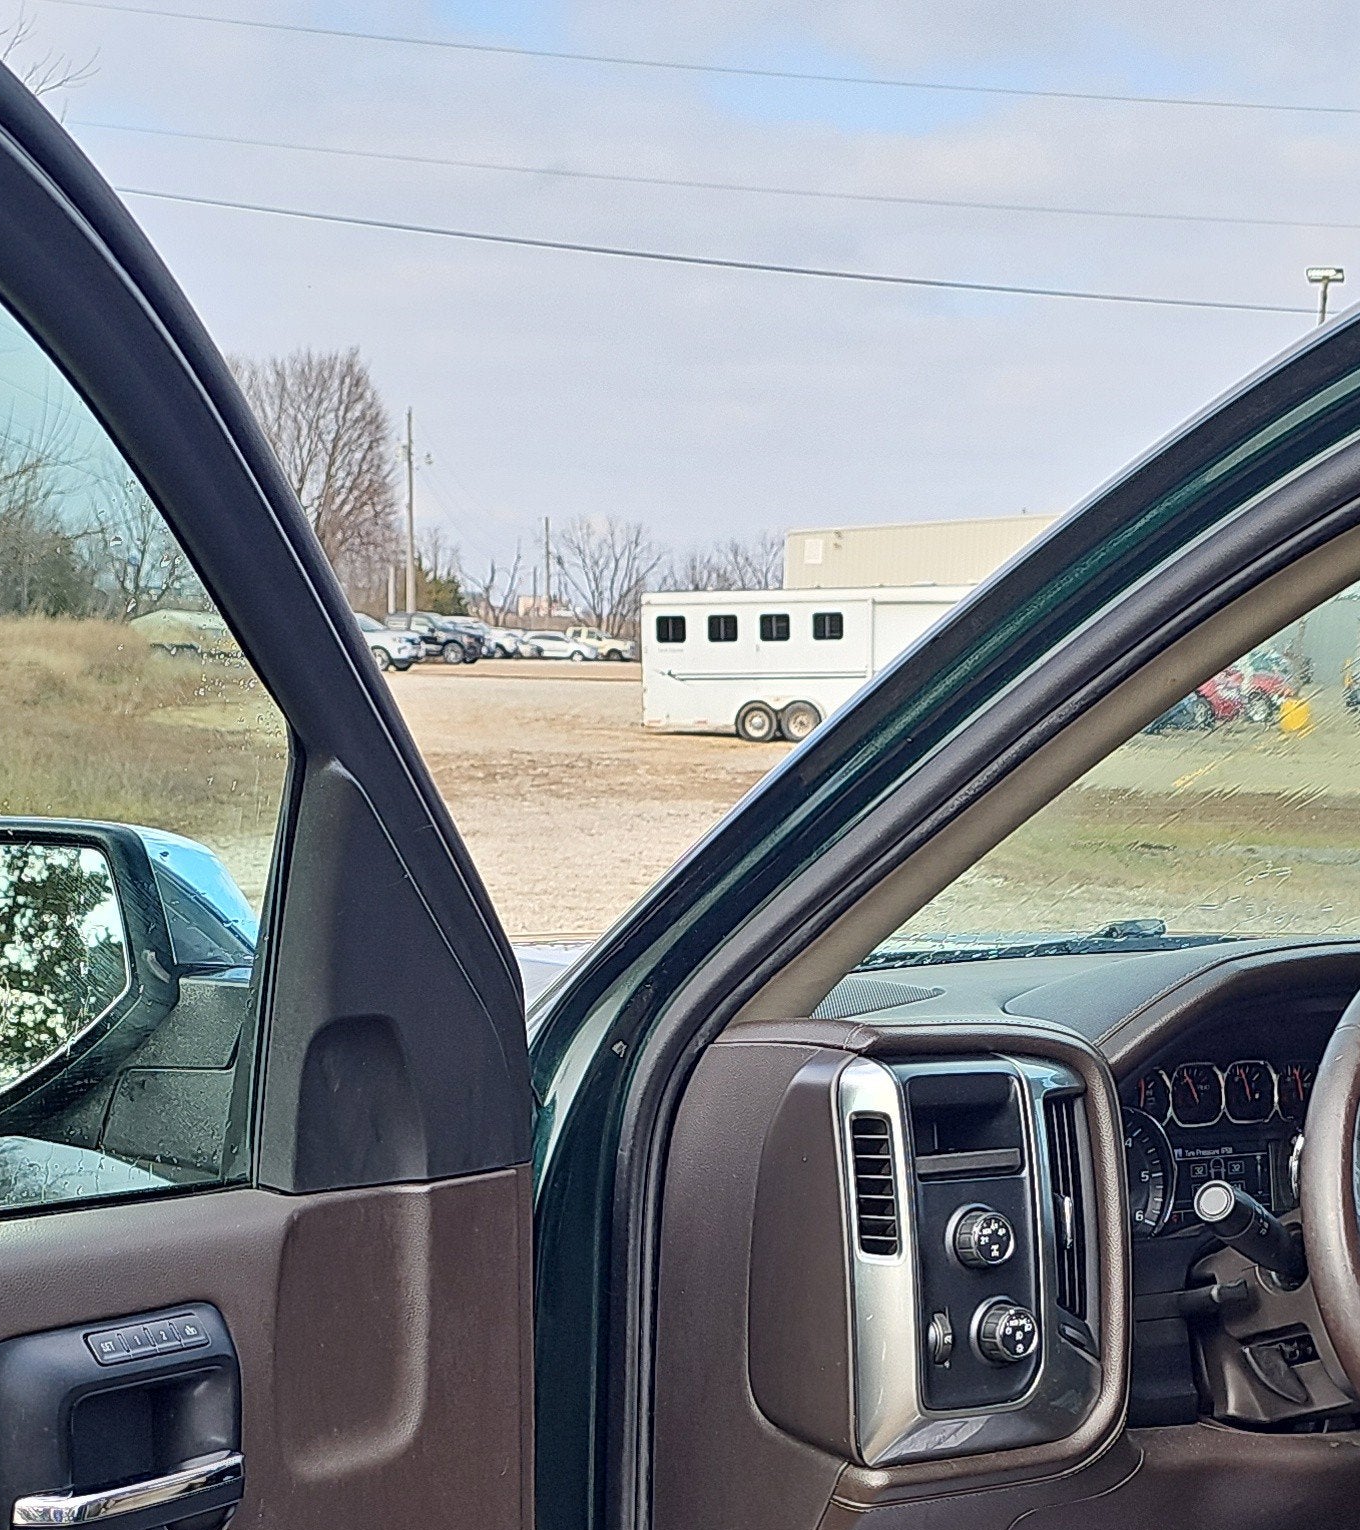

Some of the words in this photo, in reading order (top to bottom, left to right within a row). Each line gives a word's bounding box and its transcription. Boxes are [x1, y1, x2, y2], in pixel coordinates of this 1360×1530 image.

[1125, 1137, 1133, 1148] 4
[1194, 1166, 1204, 1175] 32
[1231, 1163, 1241, 1172] 32
[1140, 1171, 1150, 1182] 5
[1135, 1210, 1144, 1221] 6
[133, 1335, 141, 1346] 1
[159, 1331, 168, 1341] 2
[100, 1341, 115, 1352] SET
